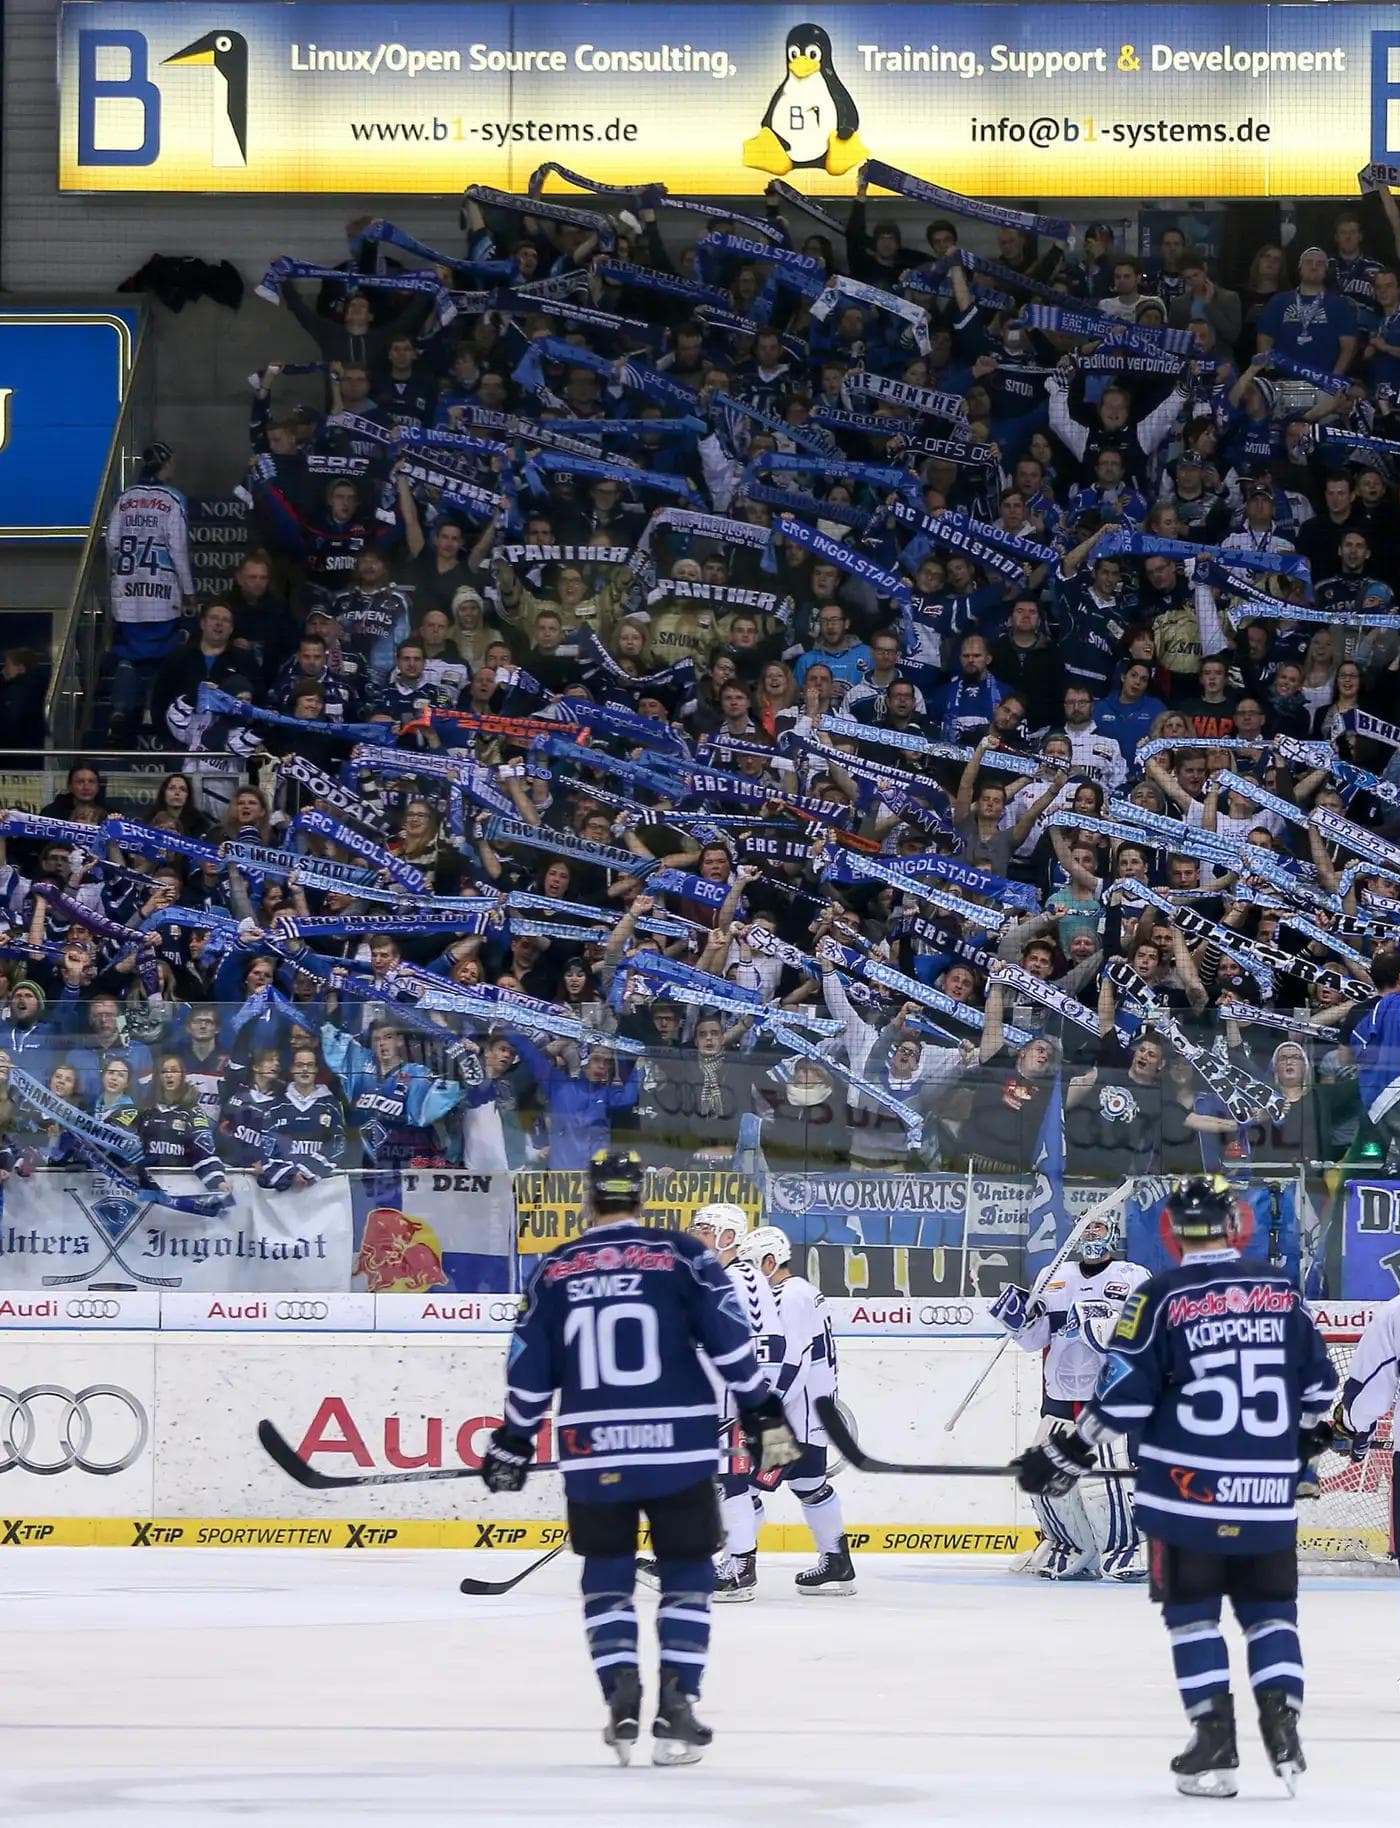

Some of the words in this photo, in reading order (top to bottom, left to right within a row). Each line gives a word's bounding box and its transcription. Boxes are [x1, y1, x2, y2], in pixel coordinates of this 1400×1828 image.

[291, 44, 460, 76] Linux/Open
[469, 44, 566, 74] Source
[573, 44, 738, 78] Consulting,
[858, 45, 985, 79] Training,
[990, 45, 1107, 80] Support
[1116, 46, 1141, 72] &
[1151, 45, 1345, 80] Development
[350, 117, 639, 148] www.b1-systems.de
[971, 117, 1271, 149] info@b1-systems.de
[307, 455, 370, 470] ERC
[308, 467, 367, 476] INGOLSTADT
[116, 535, 159, 576] 84
[505, 544, 630, 563] PANTHER
[780, 518, 811, 542] ERC
[811, 534, 903, 594] INGOLSTADT
[920, 517, 1025, 581] INGOLSTADT
[124, 582, 172, 600] SATURN
[658, 579, 779, 612] PANTHER
[694, 774, 730, 792] ERC
[732, 777, 850, 818] INGOLSTADT
[121, 822, 157, 842] ERC
[502, 818, 533, 837] ERC
[535, 827, 643, 866] INGOLSTADT
[745, 837, 779, 854] ERC
[250, 845, 356, 879] INGOLSTADT
[300, 813, 333, 834] ERC
[338, 824, 427, 892] INGOLSTADT
[694, 880, 725, 901] ERC
[431, 1174, 491, 1193] DEN
[823, 1178, 966, 1215] VORWÄRTS
[519, 1205, 558, 1239] FÜR
[208, 1301, 268, 1318] Audi
[421, 1303, 481, 1320] Audi
[851, 1307, 912, 1325] Audi
[1314, 1311, 1373, 1327] Audi
[564, 1302, 662, 1391] 10
[1185, 1315, 1285, 1351] KÖPPCHEN
[1176, 1348, 1289, 1437] 55
[592, 1423, 675, 1450] SATURN
[1216, 1476, 1289, 1504] SATURN
[196, 1527, 331, 1544] SPORTWETTEN
[882, 1534, 1018, 1550] SPORTWETTEN
